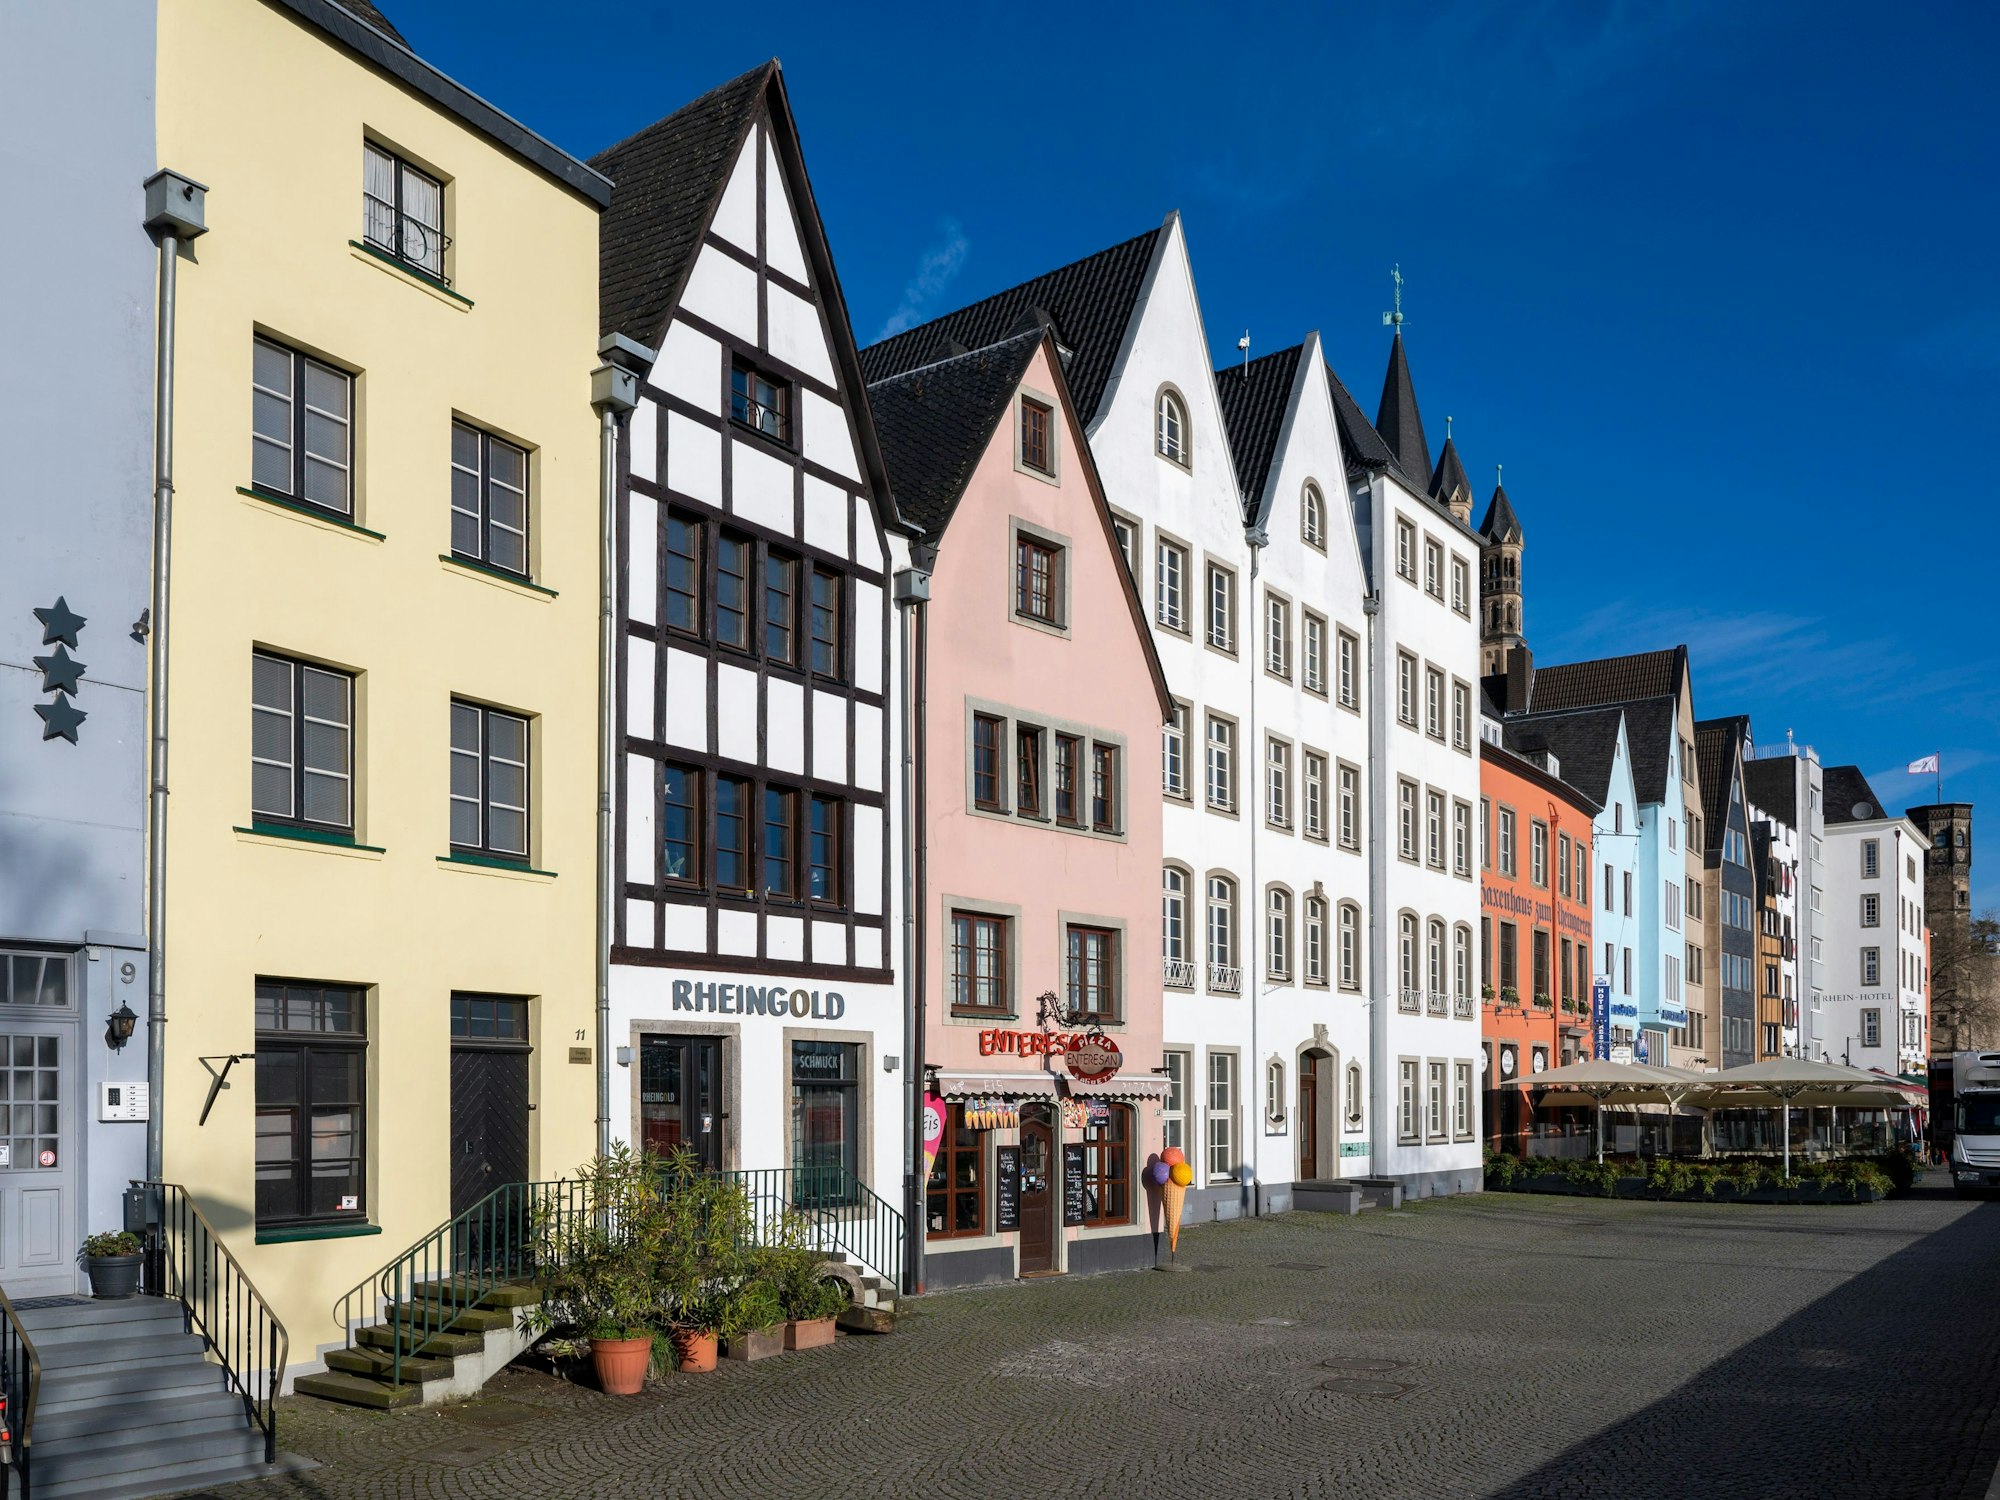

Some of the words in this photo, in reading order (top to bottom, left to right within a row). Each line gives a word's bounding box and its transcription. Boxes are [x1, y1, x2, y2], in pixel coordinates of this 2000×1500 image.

[1535, 901, 1551, 924] zum
[121, 962, 136, 985] 9
[672, 979, 846, 1021] RHEINGOLD
[1597, 987, 1605, 1016] HOTEL
[575, 1028, 586, 1041] 11
[800, 1055, 838, 1069] SCHMUCK
[1067, 1052, 1118, 1066] ENTERESAN
[642, 1092, 675, 1103] RHEINGOLD
[1090, 1107, 1110, 1117] PIZZA
